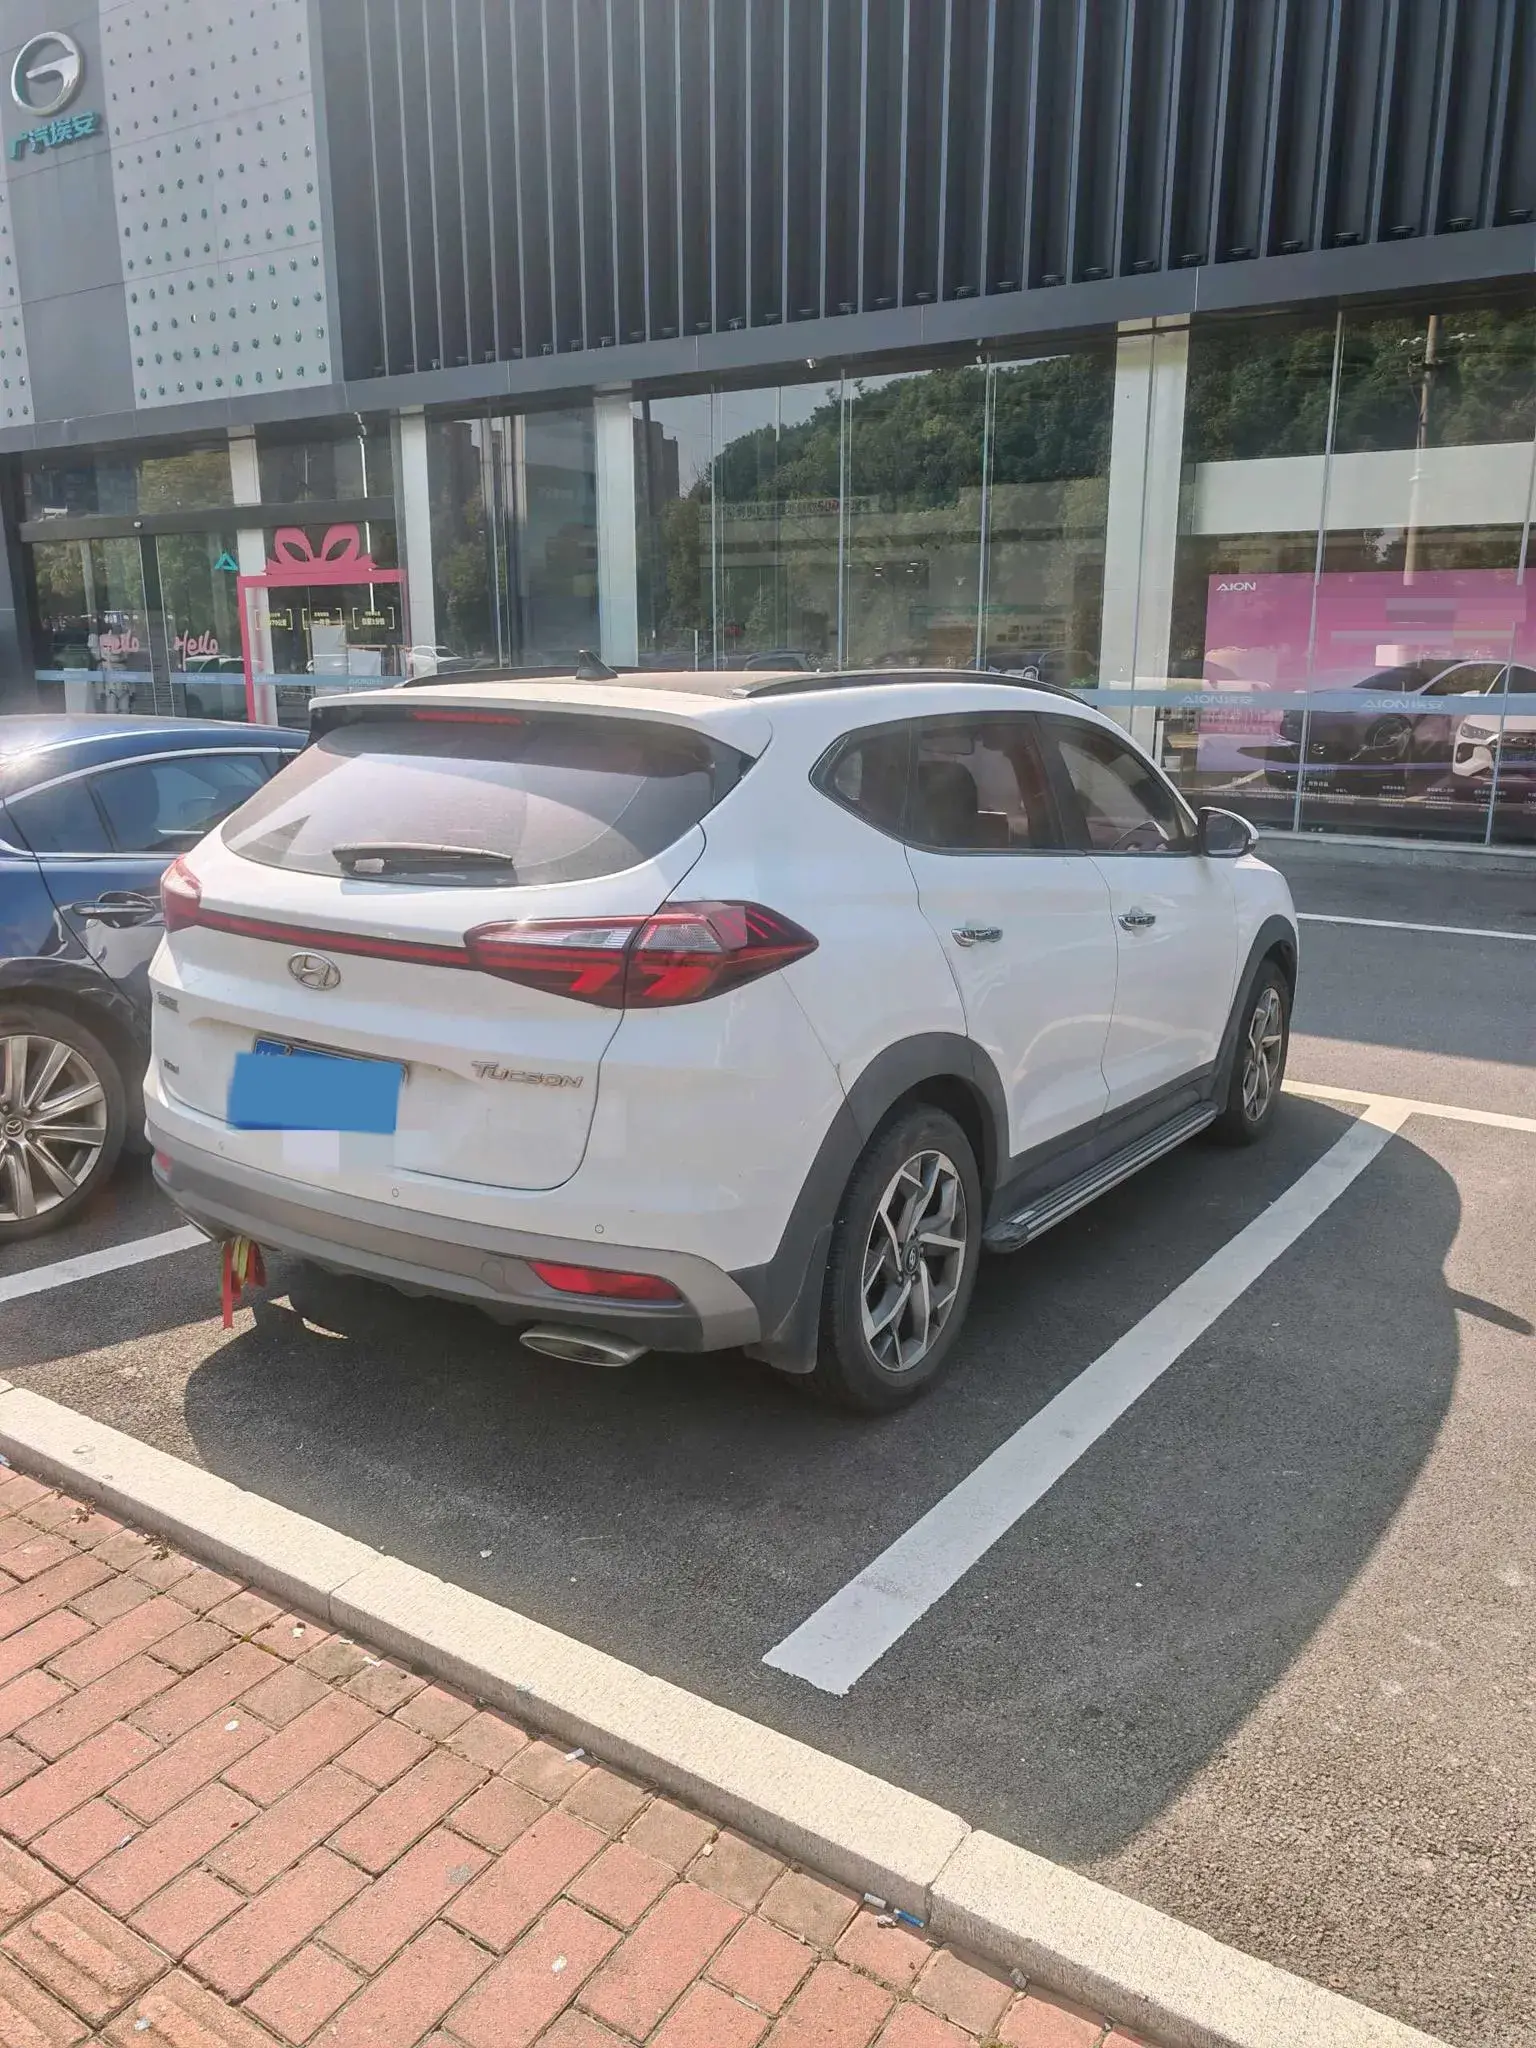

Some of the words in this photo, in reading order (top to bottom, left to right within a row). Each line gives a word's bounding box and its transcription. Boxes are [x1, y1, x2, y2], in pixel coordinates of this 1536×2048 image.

[9, 111, 96, 159] 广汽埃安
[1216, 581, 1257, 592] AION
[173, 629, 219, 672] Hello
[471, 1060, 584, 1088] TUCSON
